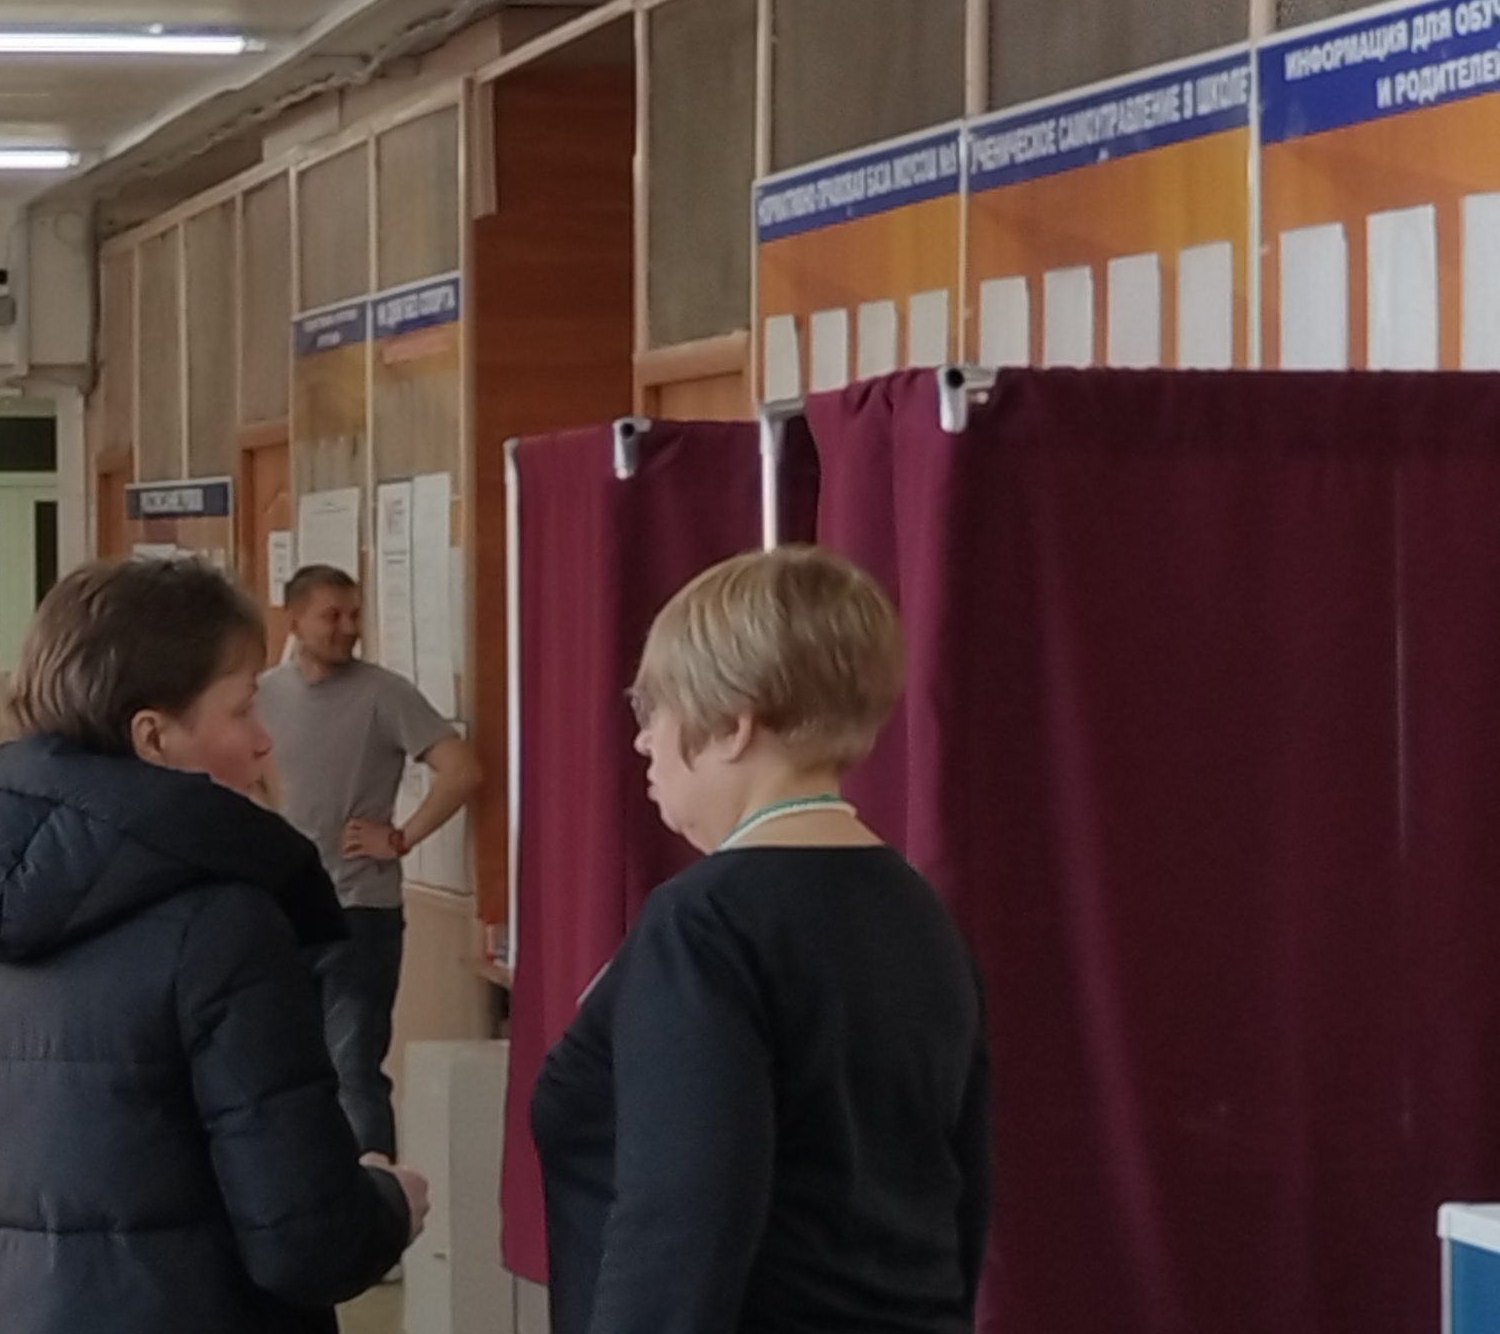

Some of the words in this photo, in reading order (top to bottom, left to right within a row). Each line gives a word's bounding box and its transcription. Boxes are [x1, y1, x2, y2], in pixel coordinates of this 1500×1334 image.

[1285, 19, 1409, 81] ИНФОРМАЦИЯ
[1411, 7, 1453, 53] ДЛЯ
[1196, 65, 1249, 117] ШКОЛЕ
[1376, 76, 1393, 109] И
